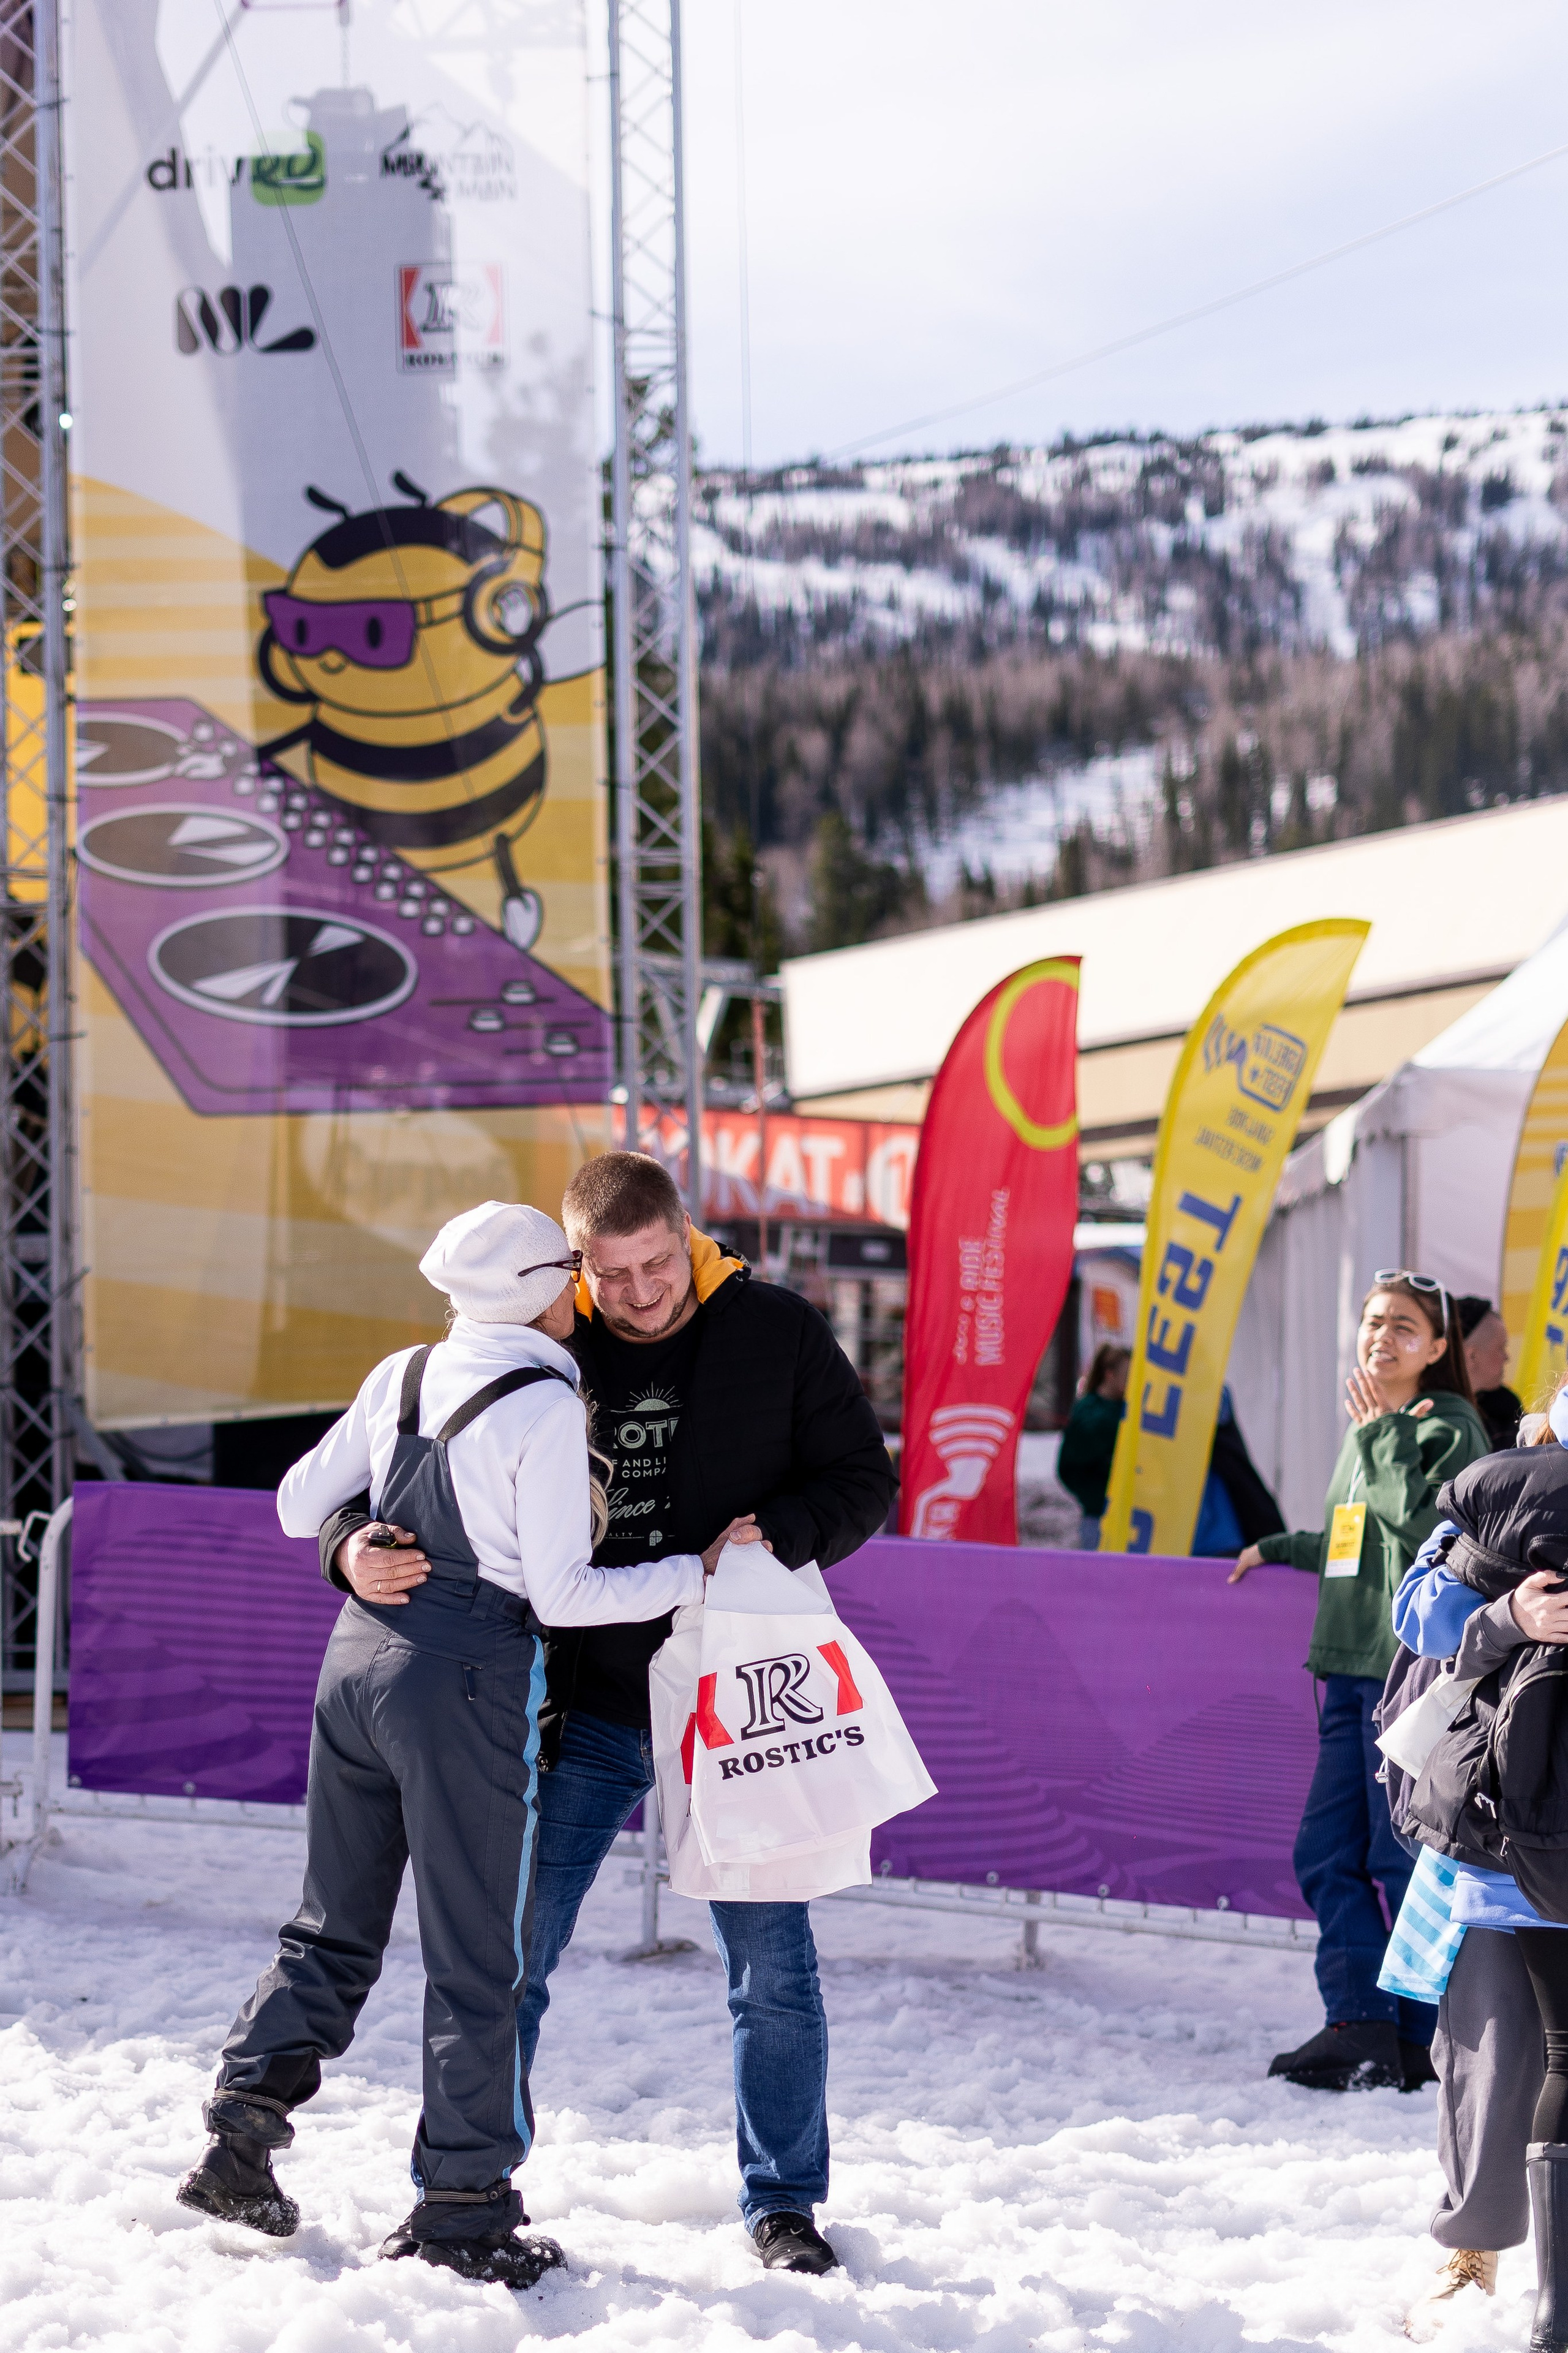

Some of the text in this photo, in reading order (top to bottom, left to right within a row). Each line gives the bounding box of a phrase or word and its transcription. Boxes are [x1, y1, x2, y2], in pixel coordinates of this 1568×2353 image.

[975, 1188, 1009, 1365] MUSIC FESTIVAL
[622, 1459, 651, 1468] AND
[736, 1653, 824, 1741] R
[718, 1726, 865, 1780] ROSTIC'S
